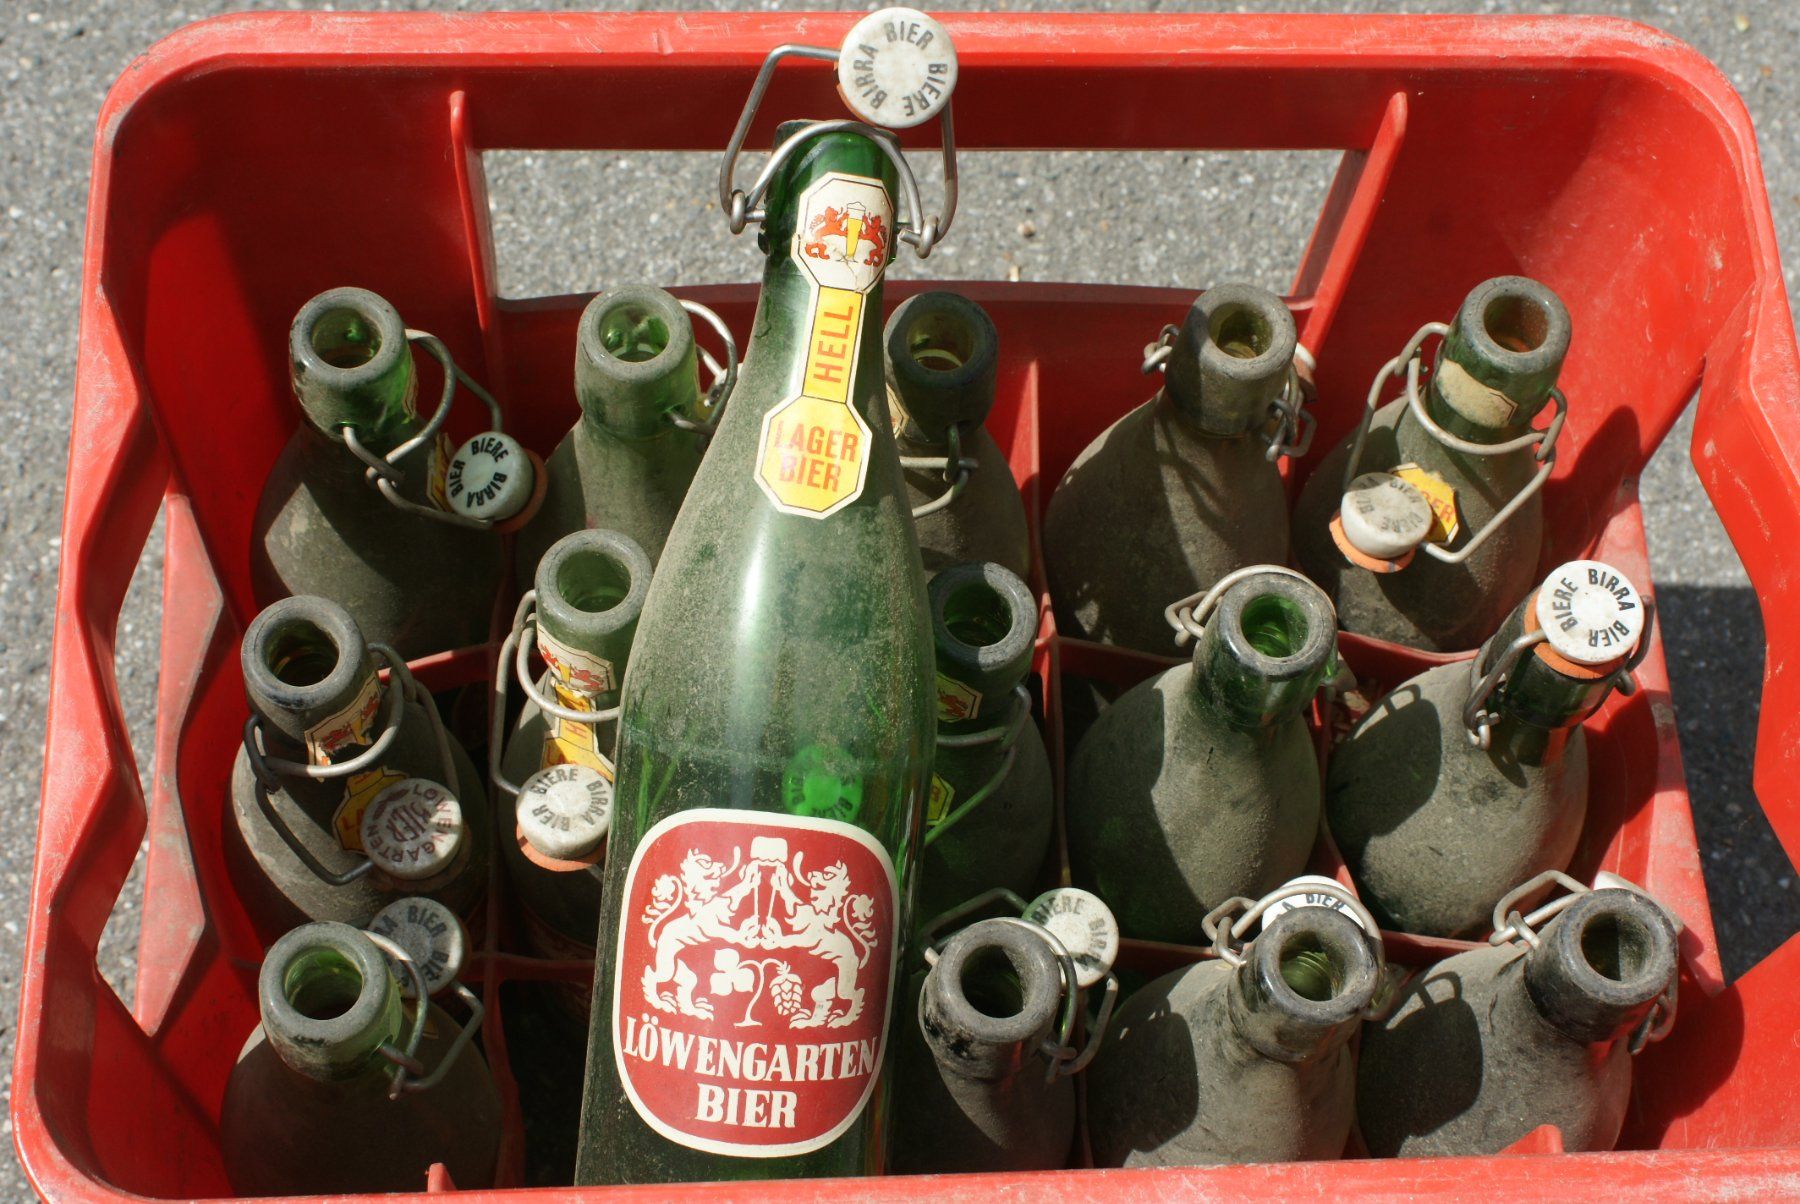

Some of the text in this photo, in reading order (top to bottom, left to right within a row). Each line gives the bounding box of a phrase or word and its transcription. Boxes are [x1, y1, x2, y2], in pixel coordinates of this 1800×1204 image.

[884, 20, 934, 50] BIER
[852, 43, 888, 110] BIRRA
[904, 63, 948, 118] BIERE
[813, 305, 854, 384] HELL
[471, 437, 509, 463] BIERE
[774, 420, 859, 462] LAGER
[449, 459, 466, 498] BIER
[466, 472, 508, 508] BIRRA
[779, 455, 842, 492] BIER
[1552, 577, 1579, 632] BIERE
[1587, 568, 1636, 611] BIRRA
[1588, 620, 1630, 648] BIER
[528, 768, 578, 795] BIERE
[532, 805, 571, 832] BIER
[581, 780, 609, 826] BIRRA
[408, 905, 447, 938] BIER
[623, 1013, 878, 1082] LÖWENGARTEN
[694, 1083, 798, 1129] BIER
